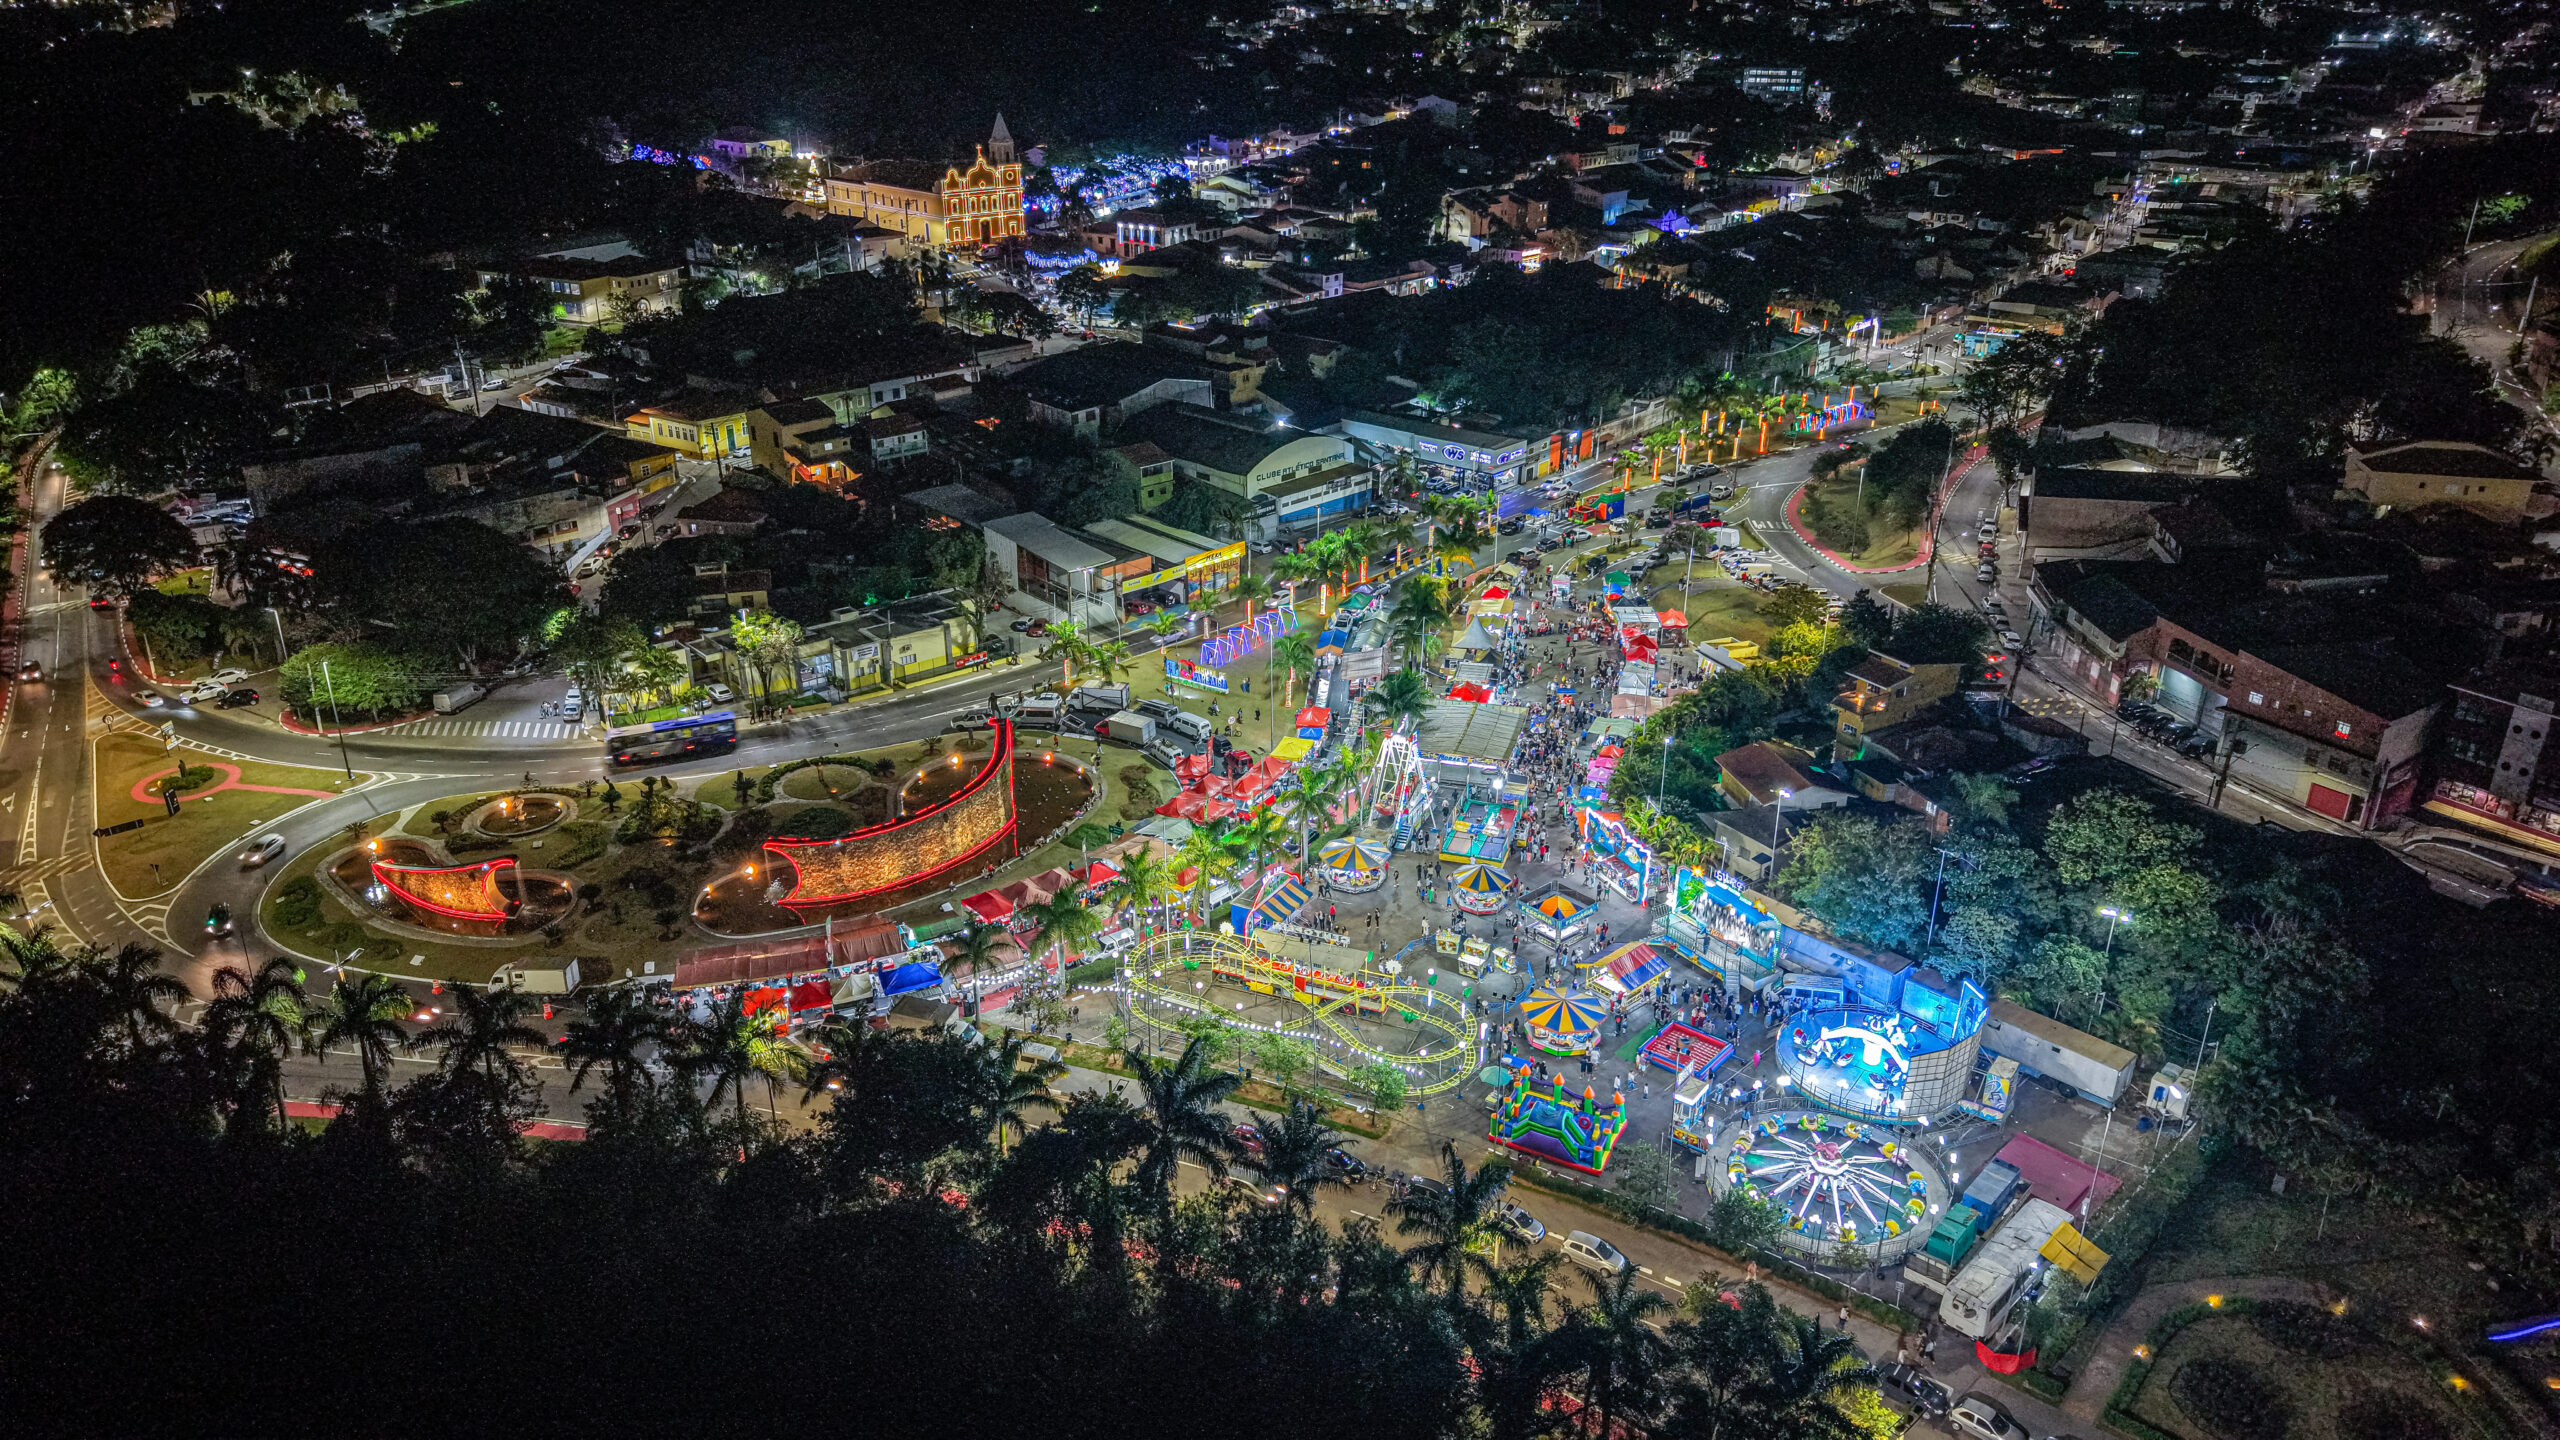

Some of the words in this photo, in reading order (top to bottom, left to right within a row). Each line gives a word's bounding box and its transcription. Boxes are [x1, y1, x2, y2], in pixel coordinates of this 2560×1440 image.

[1256, 469, 1281, 482] CLUBE
[1282, 461, 1313, 475] ATLÉTICO
[1316, 453, 1345, 466] SANTANA
[1521, 905, 1552, 925] PESCARIA
